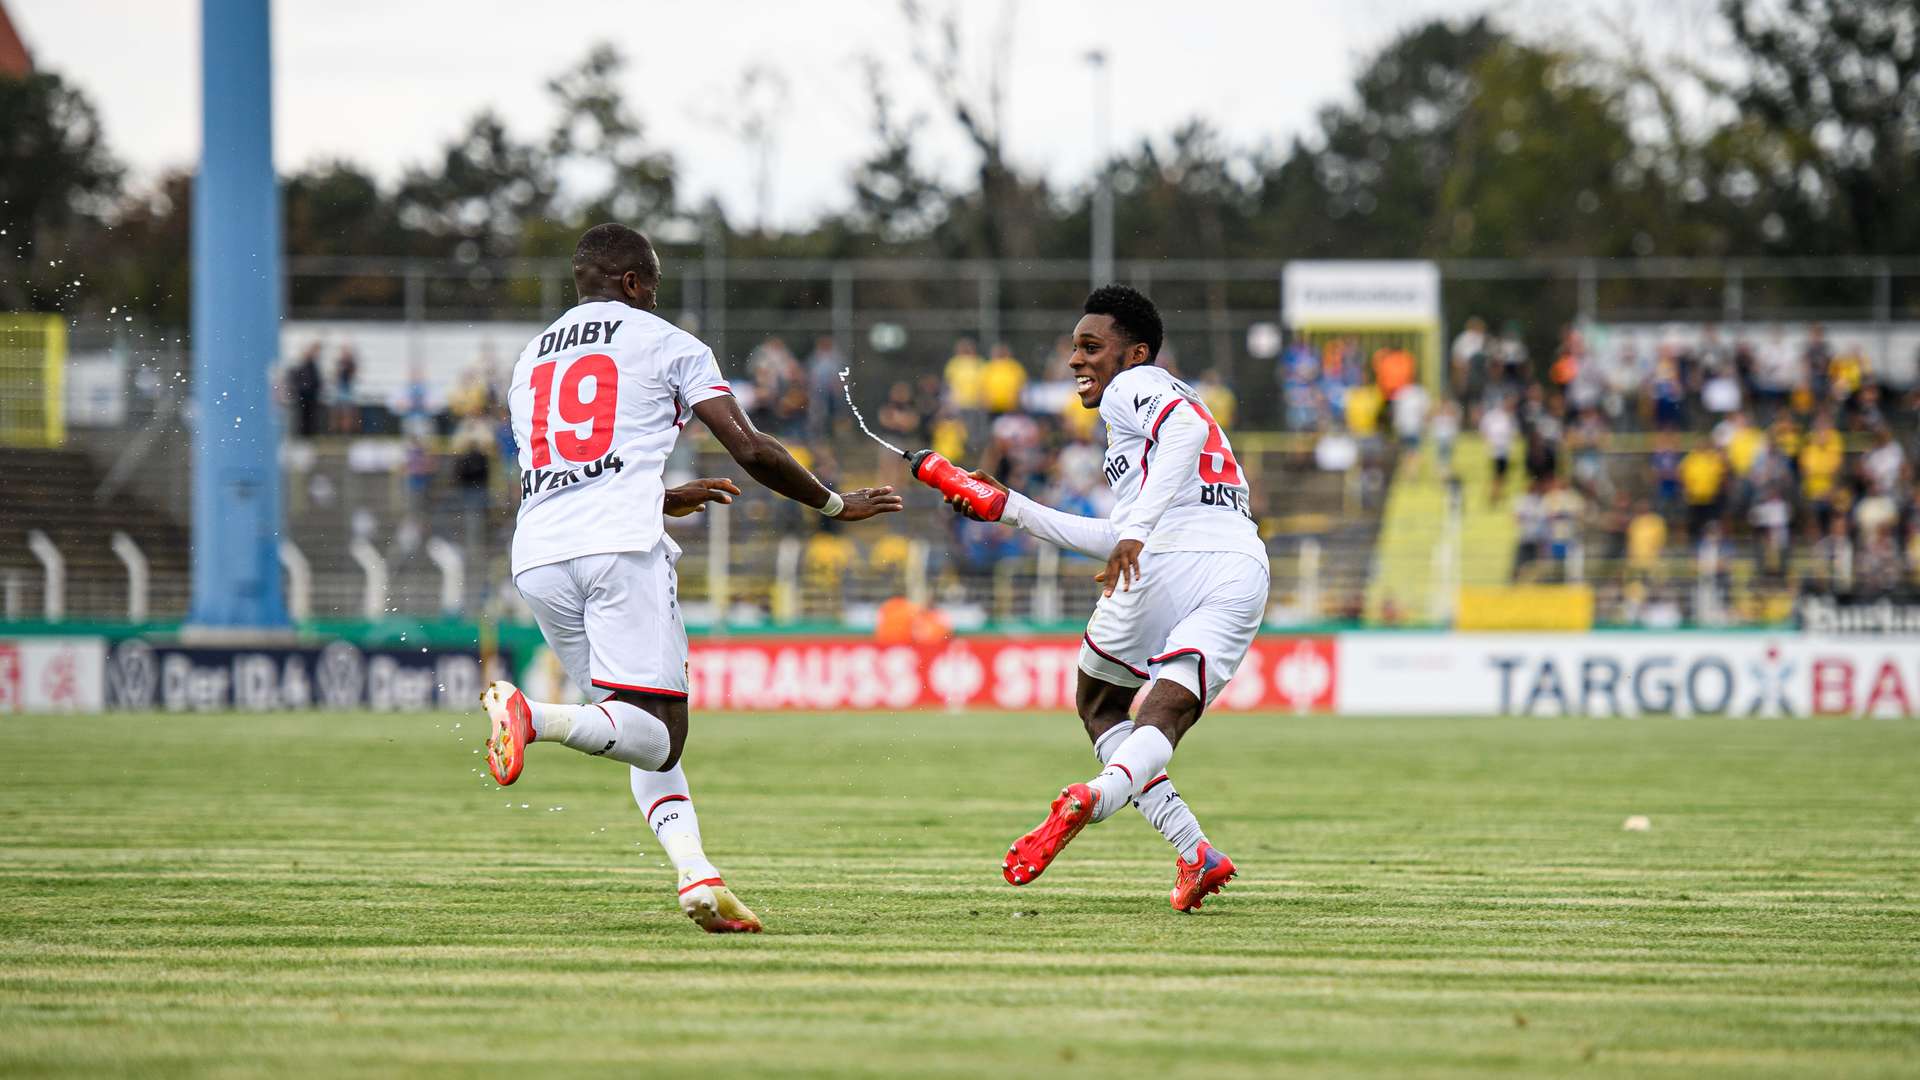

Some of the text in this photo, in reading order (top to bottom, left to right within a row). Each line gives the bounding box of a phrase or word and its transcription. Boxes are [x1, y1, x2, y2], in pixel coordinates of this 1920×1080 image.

[537, 320, 623, 358] DIABY
[529, 354, 618, 469] 19
[521, 468, 580, 500] AYER
[162, 652, 230, 713] Der
[369, 655, 432, 712] Der
[1811, 657, 1920, 716] BA
